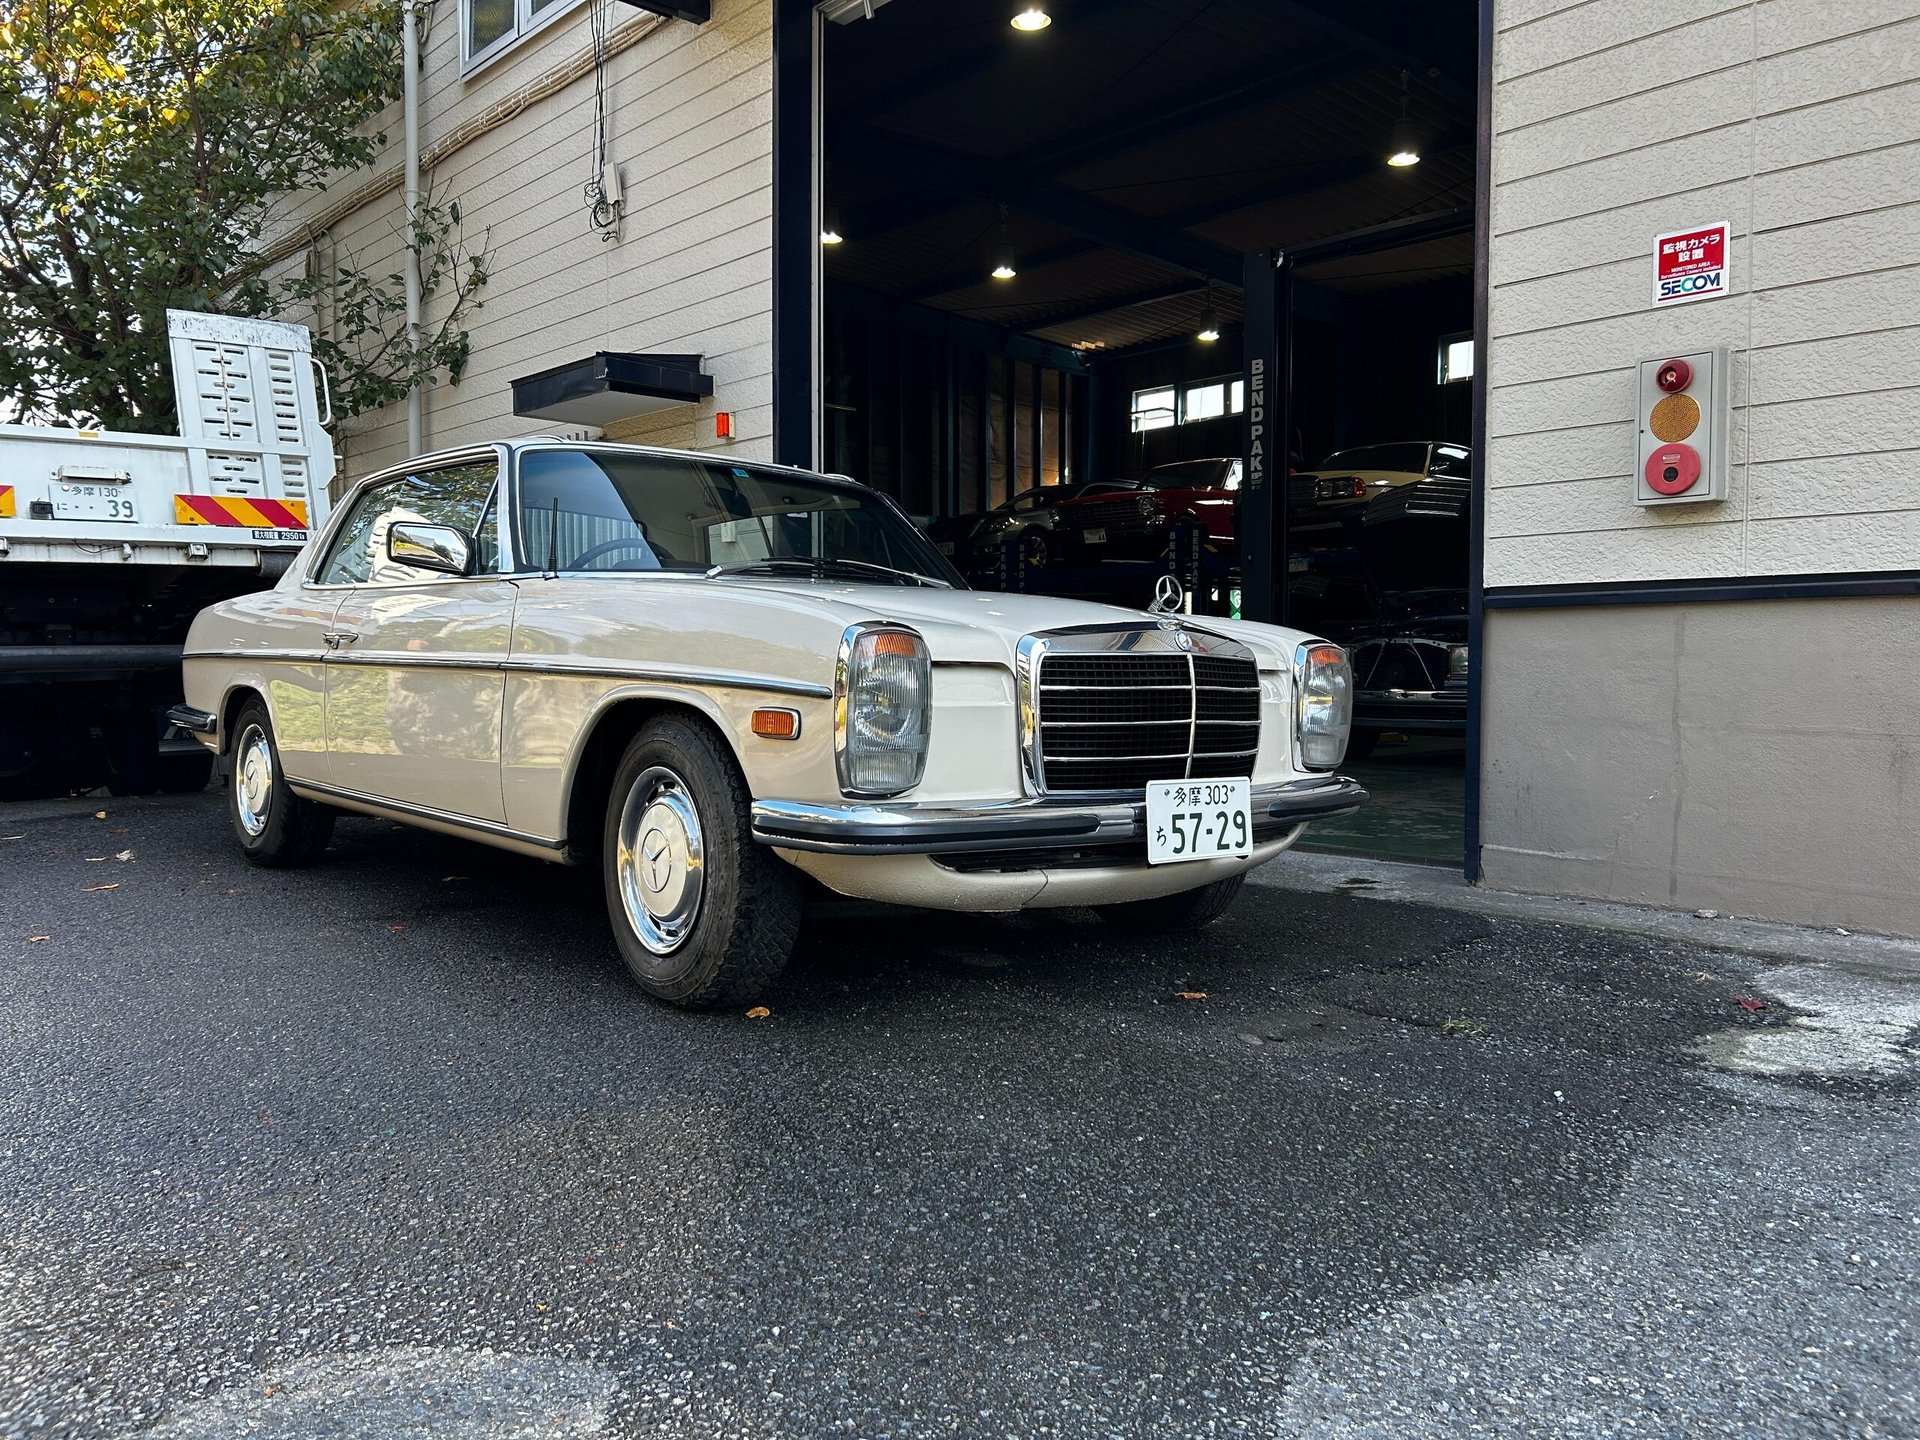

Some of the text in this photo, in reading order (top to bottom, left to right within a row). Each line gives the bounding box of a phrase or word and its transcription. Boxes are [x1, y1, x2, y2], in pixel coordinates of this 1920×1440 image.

[1663, 234, 1720, 254] 監視カメラ
[1678, 248, 1704, 262] 設置
[1661, 272, 1721, 297] SECOM
[1250, 359, 1264, 471] BENDPAK
[98, 487, 118, 498] 130
[107, 499, 134, 518] 39
[1173, 784, 1229, 807] 多摩 303
[1156, 809, 1247, 854] ち 57-29
